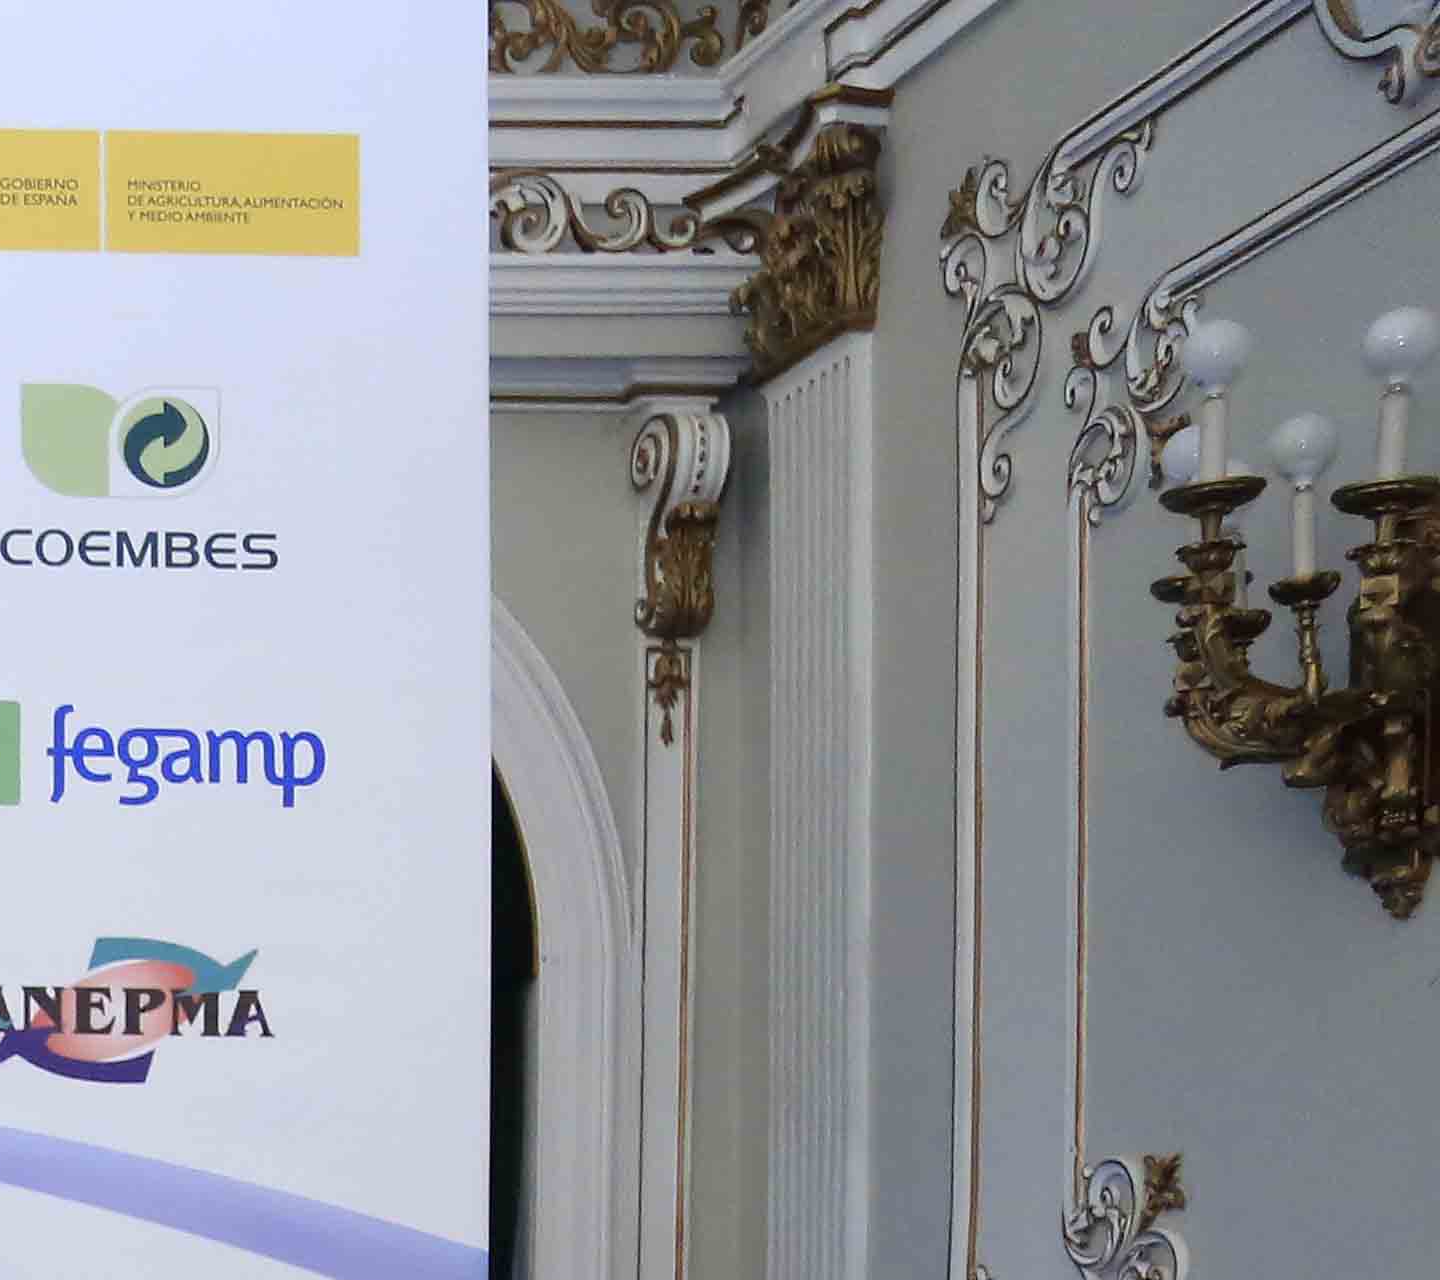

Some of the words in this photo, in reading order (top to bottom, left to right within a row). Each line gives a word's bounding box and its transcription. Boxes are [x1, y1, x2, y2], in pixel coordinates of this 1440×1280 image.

[0, 177, 79, 191] GOBIERNO
[127, 179, 201, 192] MINISTERIO
[0, 193, 19, 206] DE
[23, 191, 78, 207] ESPAÑA
[127, 195, 146, 207] DE
[127, 210, 135, 222] Y
[139, 211, 183, 223] MEDIO
[186, 211, 251, 224] AMBIENTE
[46, 703, 327, 808] fegamp
